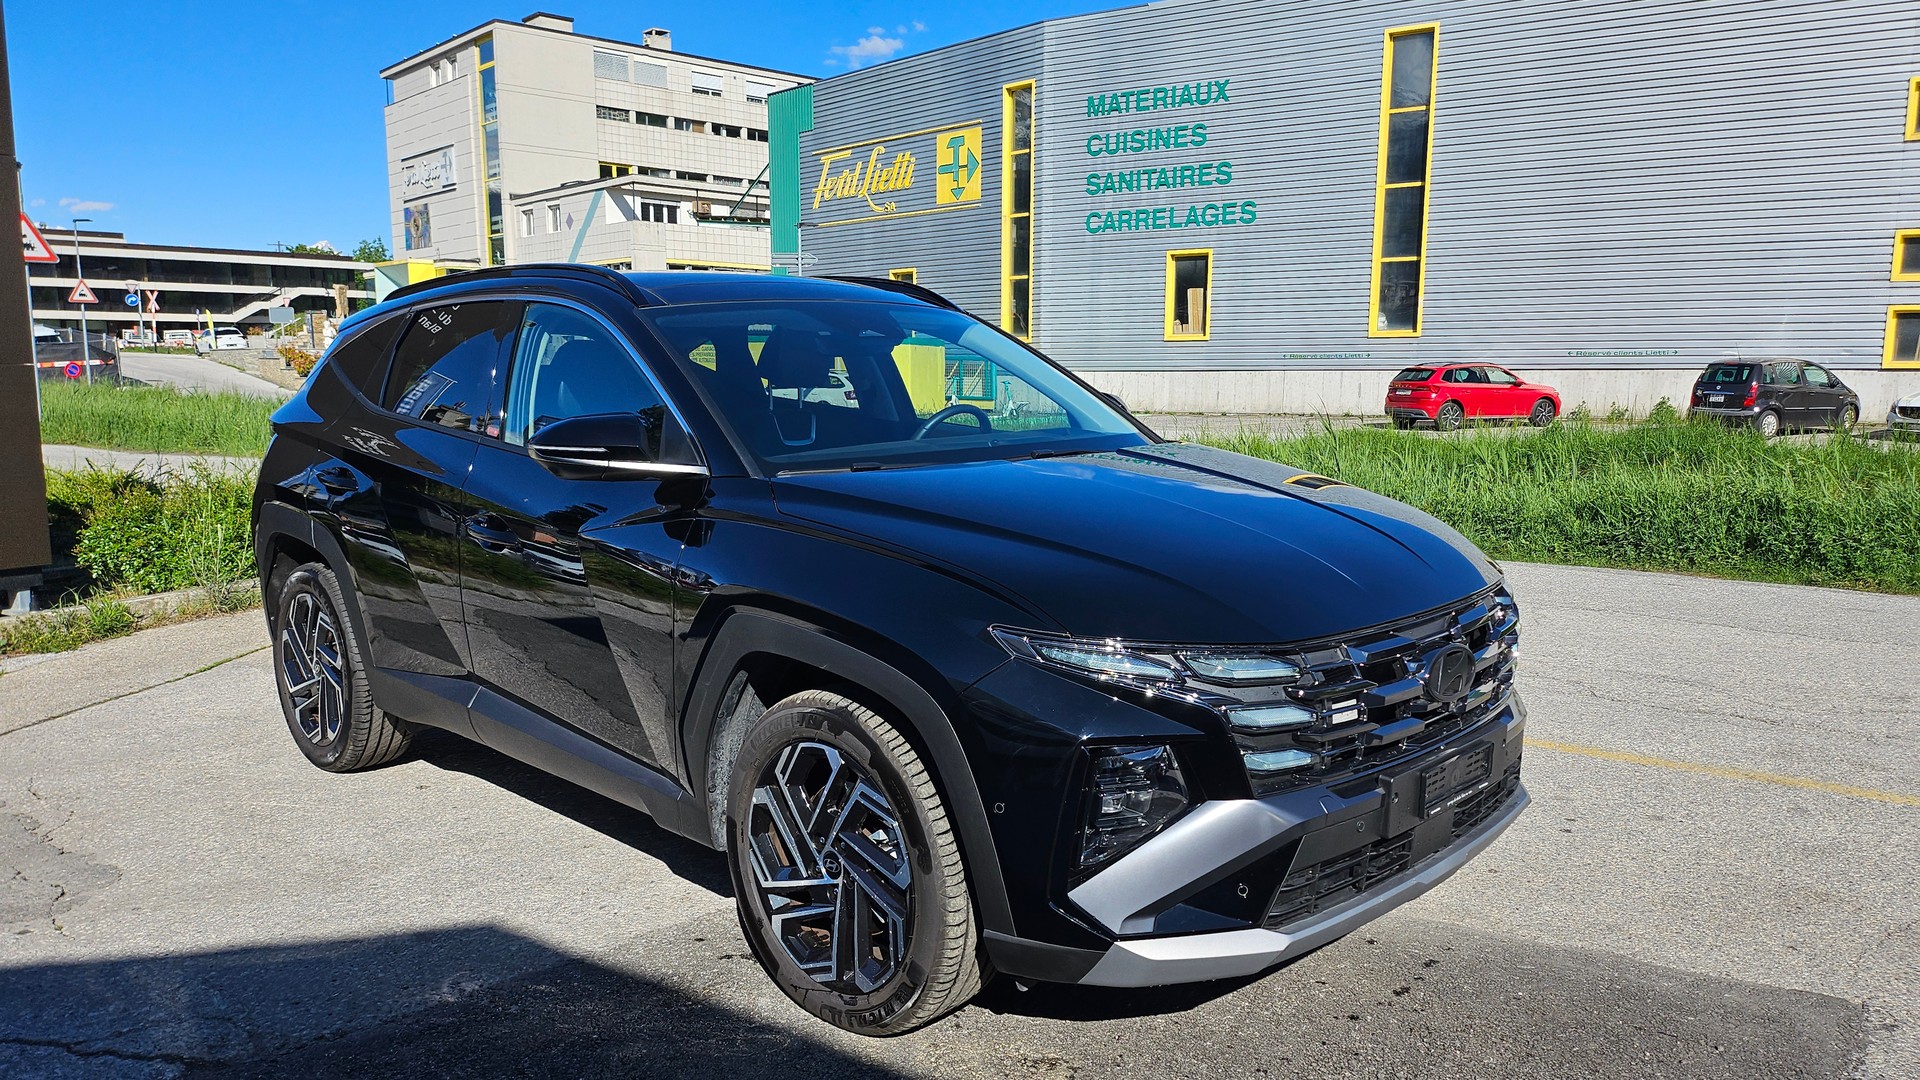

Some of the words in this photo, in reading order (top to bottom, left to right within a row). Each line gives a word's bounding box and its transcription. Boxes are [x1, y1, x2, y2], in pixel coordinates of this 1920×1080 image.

[1087, 79, 1230, 117] MATERIAUX
[1087, 123, 1208, 157] CUISINES
[858, 146, 916, 212] Lietti
[1085, 161, 1233, 196] SANITAIRES
[1085, 200, 1257, 234] CARRELAGES
